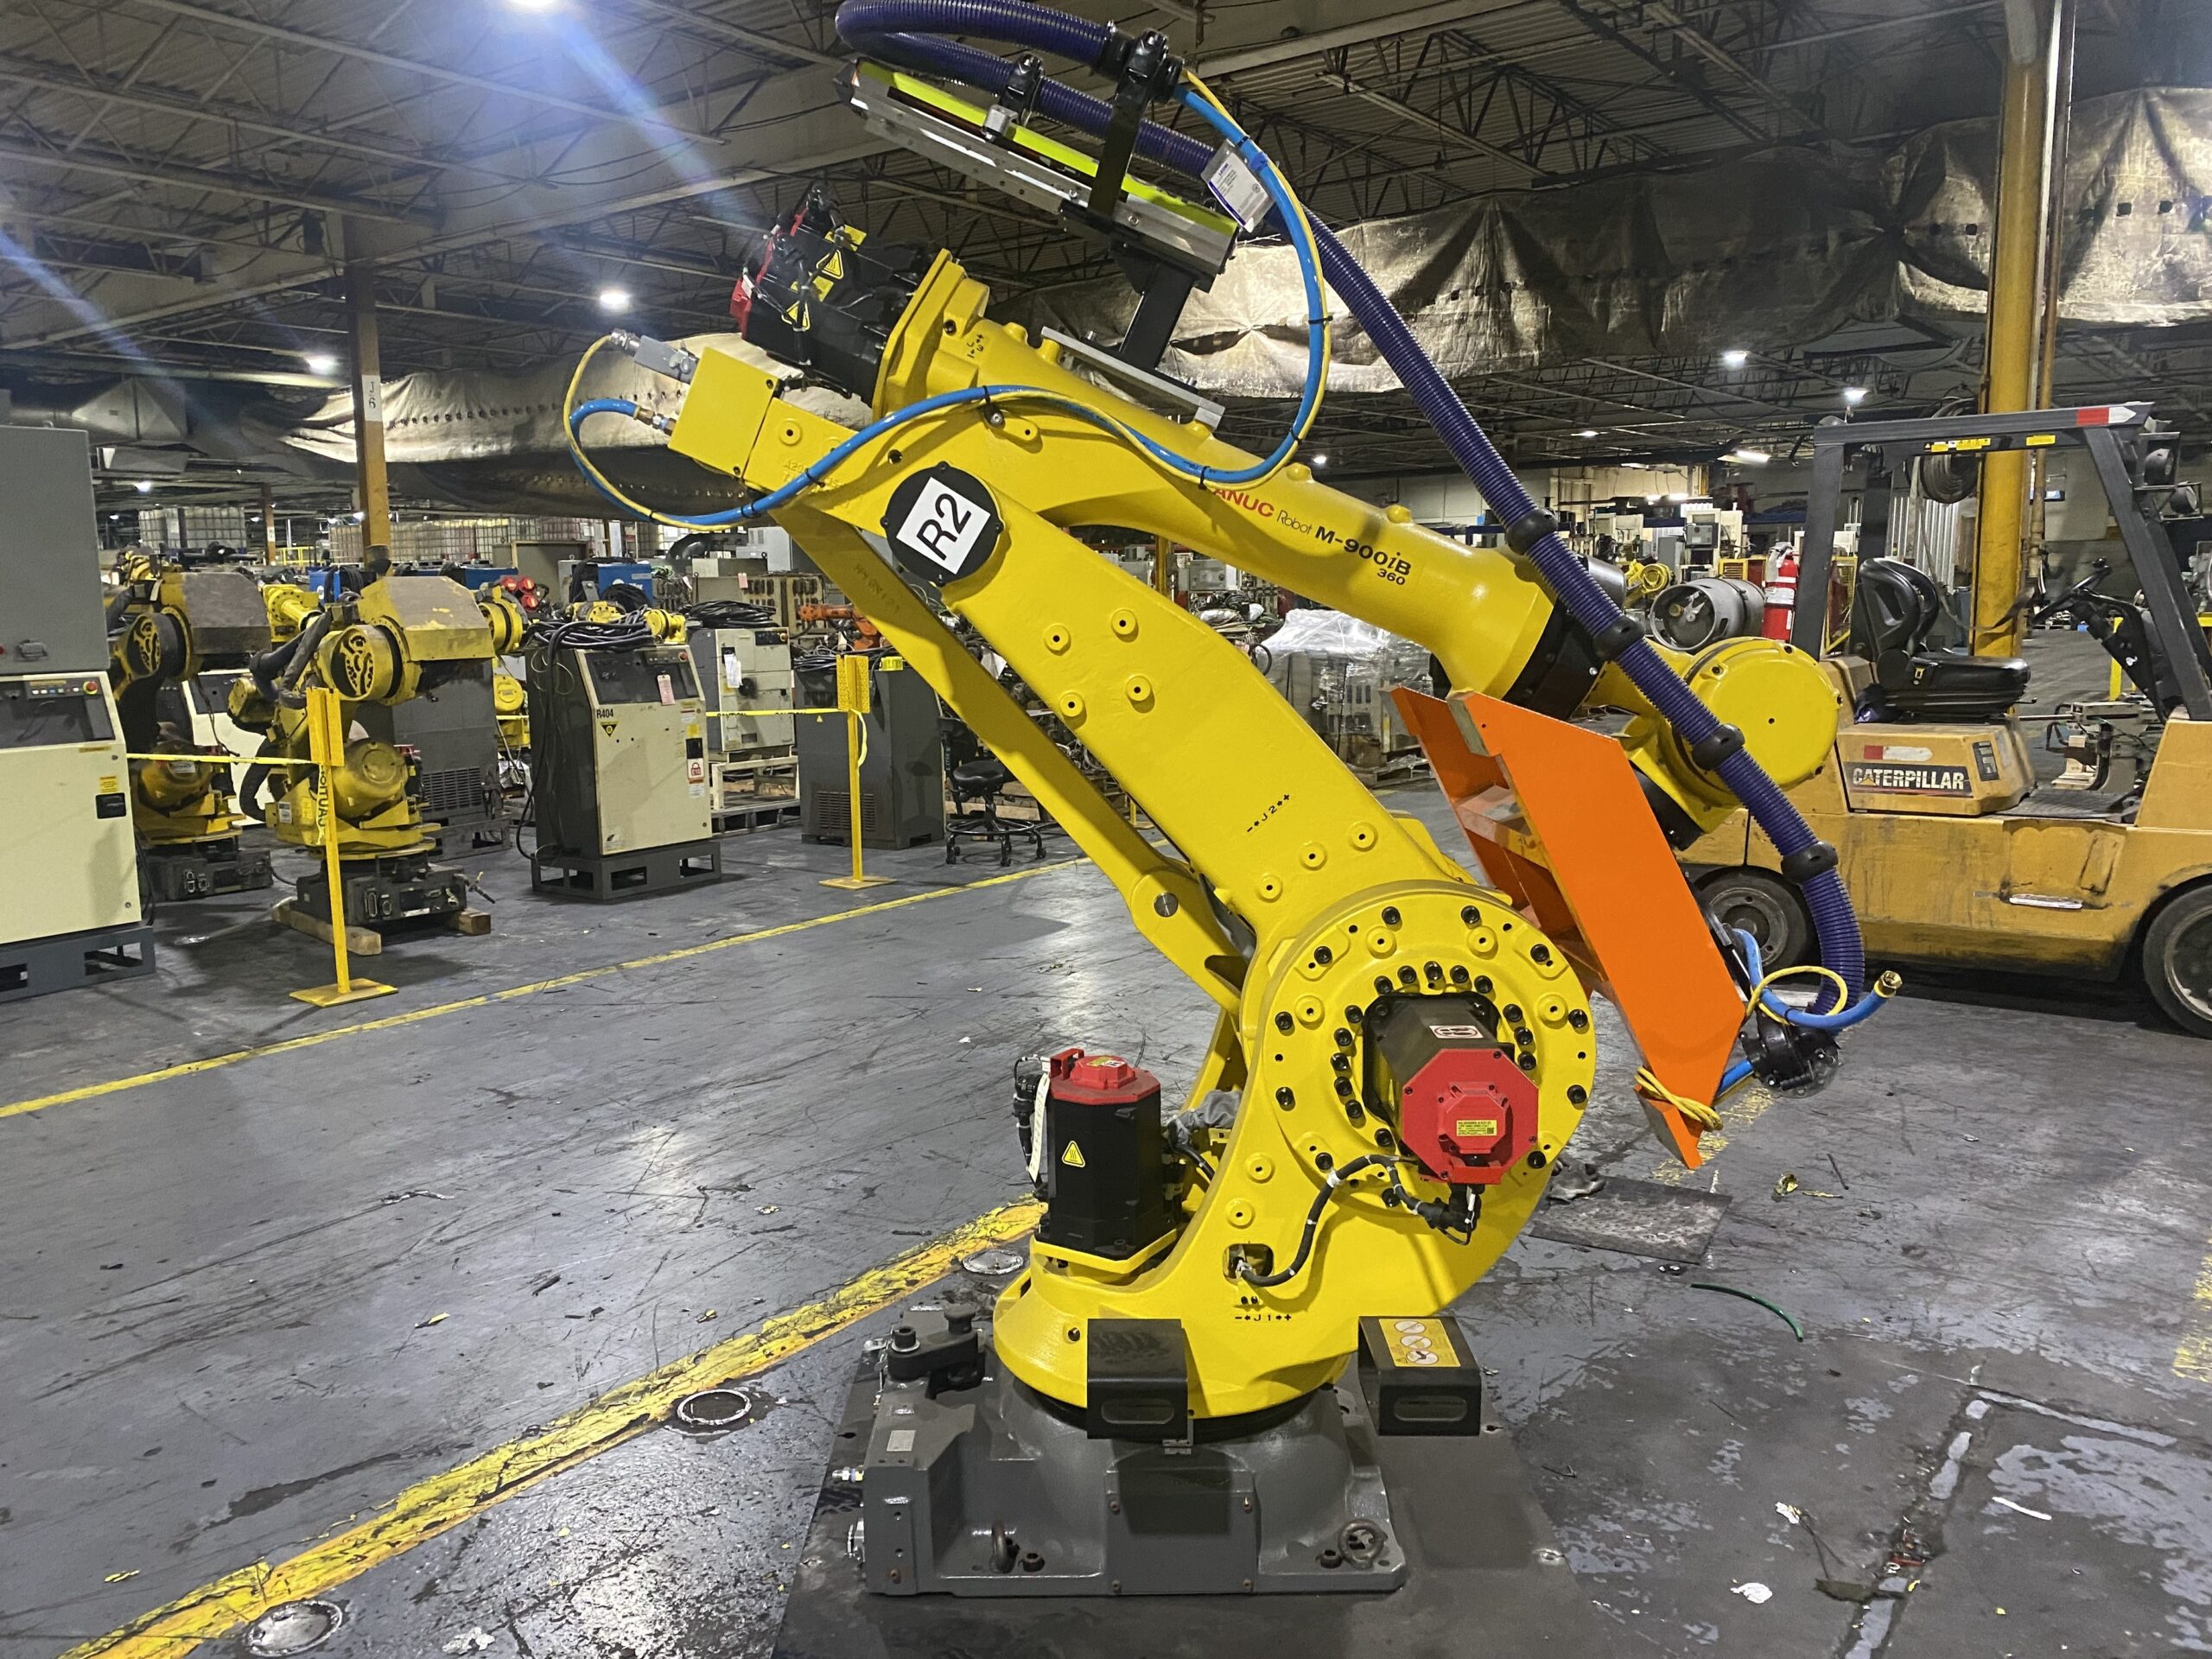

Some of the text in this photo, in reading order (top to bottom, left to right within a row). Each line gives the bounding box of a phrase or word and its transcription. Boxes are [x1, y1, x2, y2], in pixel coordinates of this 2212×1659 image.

[368, 397, 376, 409] 6
[916, 493, 972, 561] R2
[1211, 487, 1412, 576] ANUC Robot M-900iB
[1376, 568, 1406, 586] 360
[596, 709, 614, 719] R404
[1853, 767, 1964, 790] CATERPILLAR
